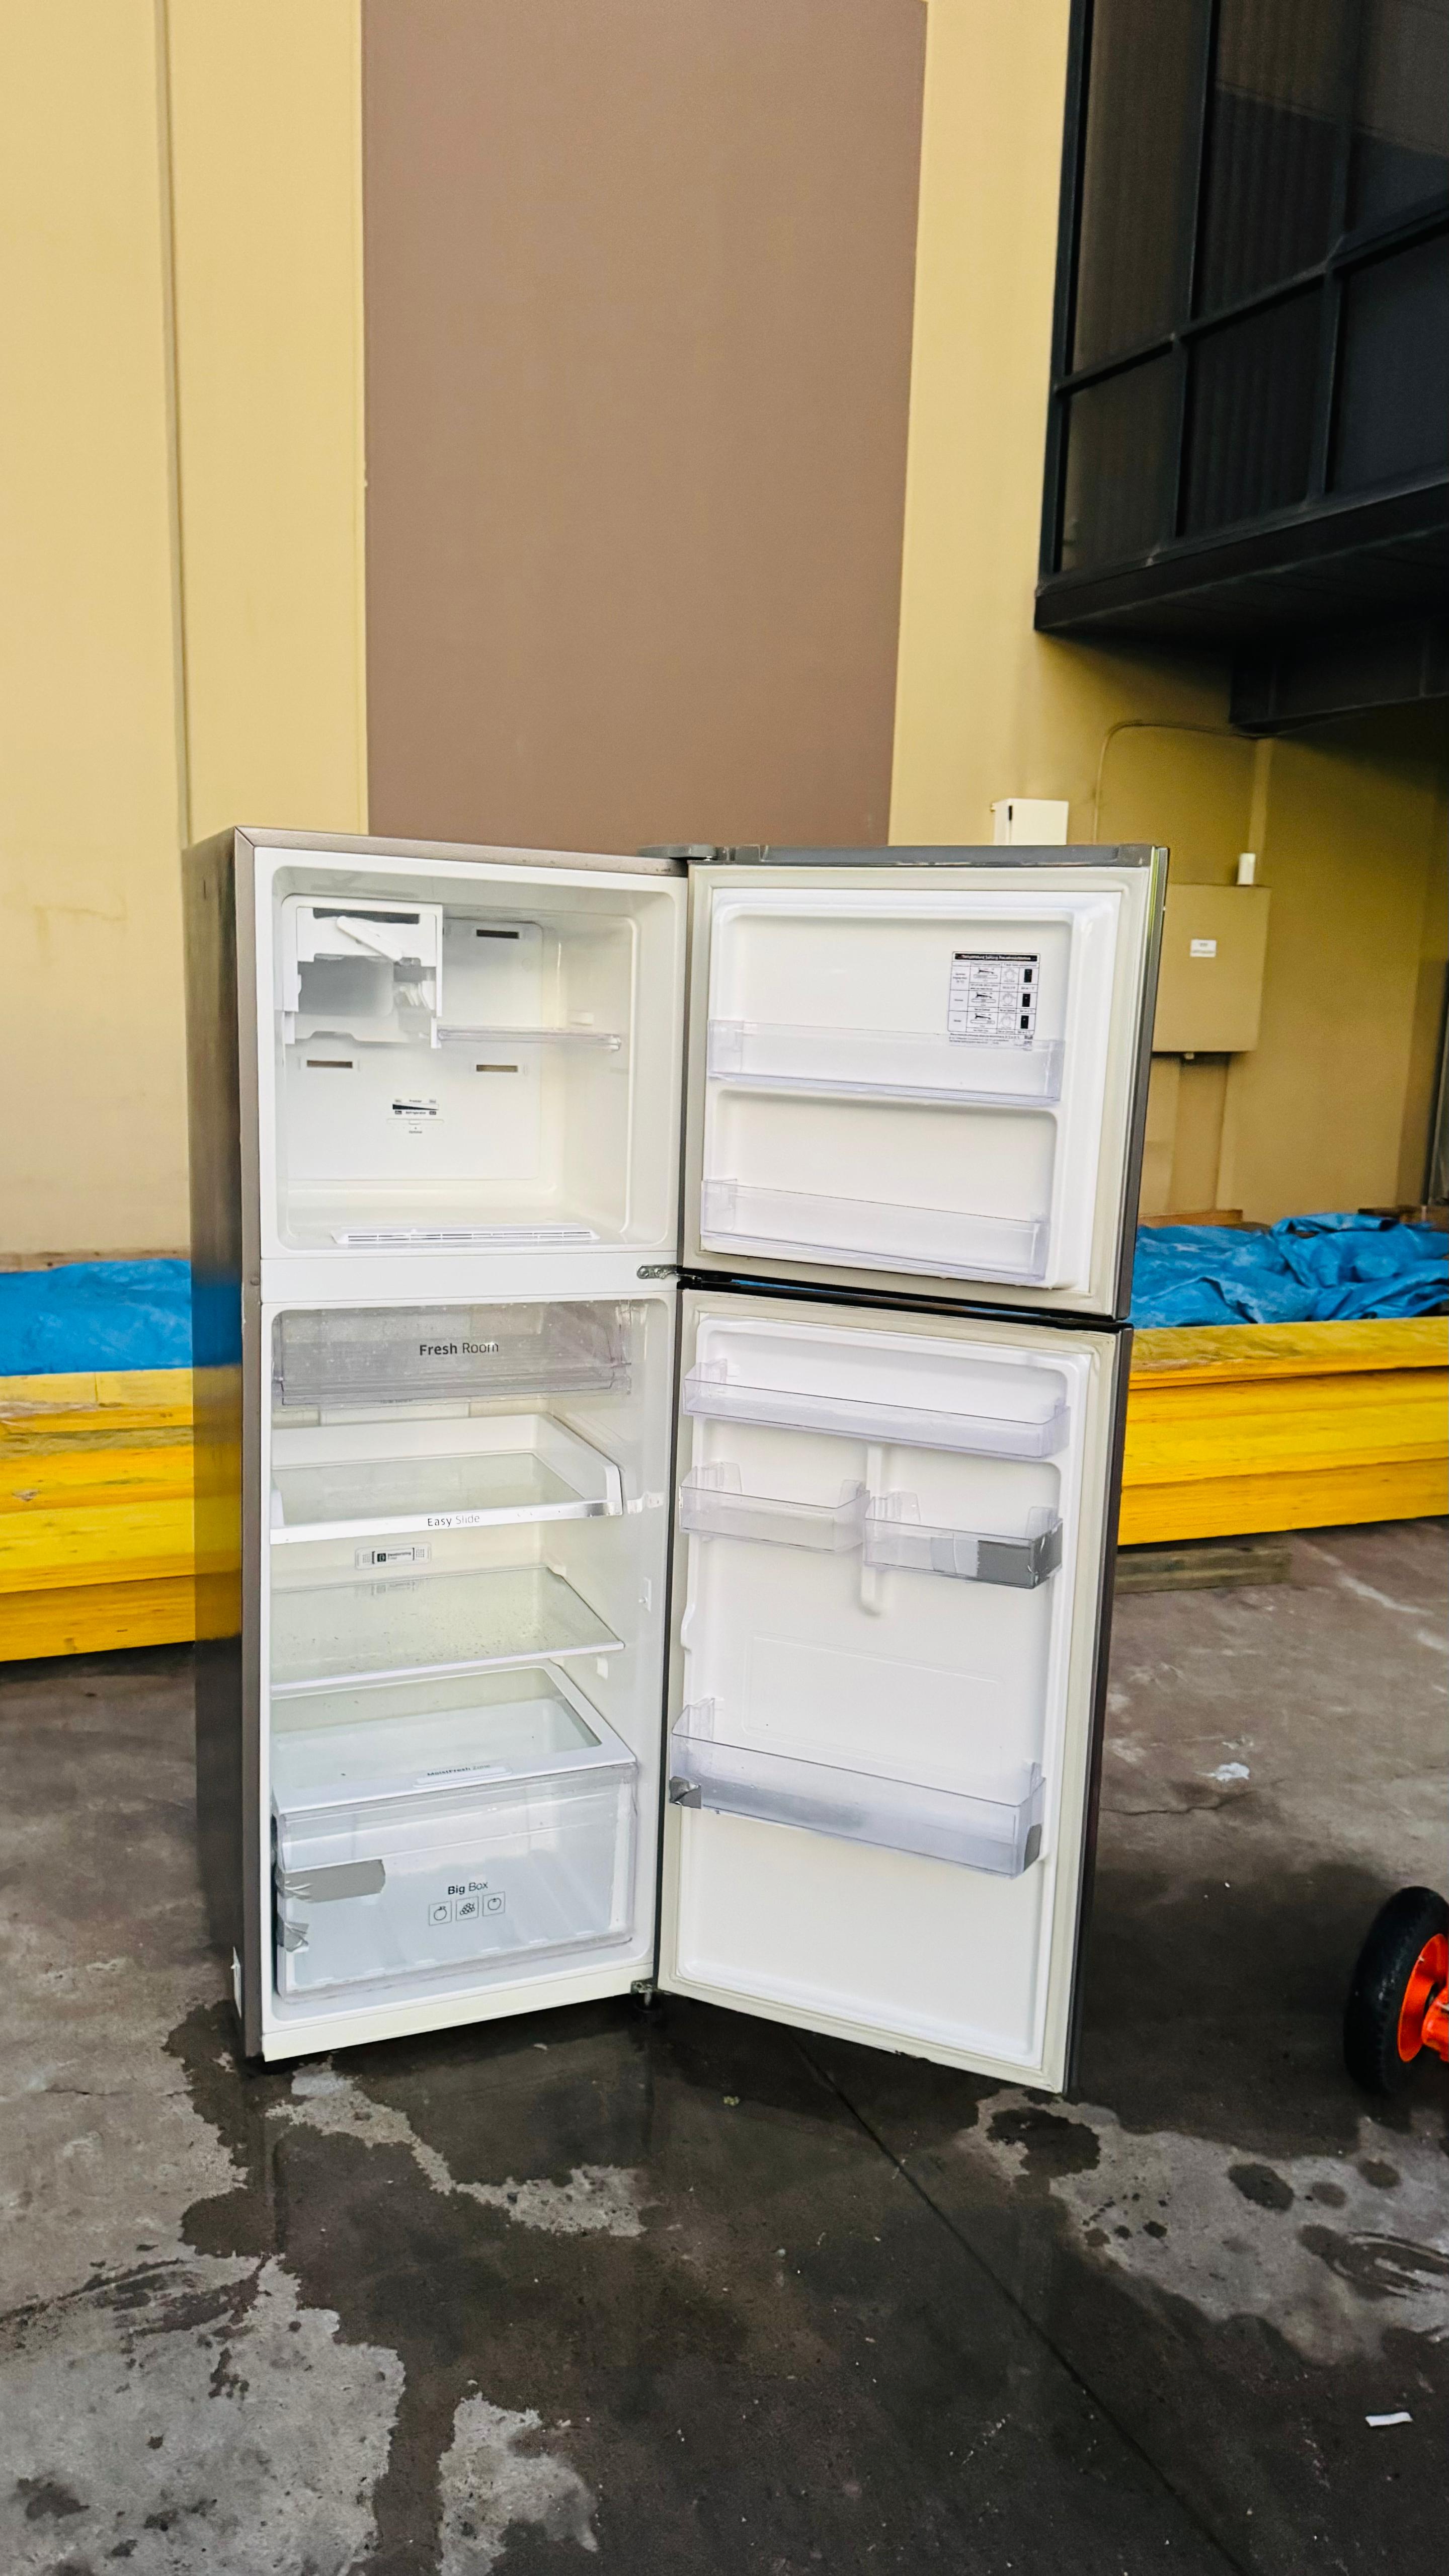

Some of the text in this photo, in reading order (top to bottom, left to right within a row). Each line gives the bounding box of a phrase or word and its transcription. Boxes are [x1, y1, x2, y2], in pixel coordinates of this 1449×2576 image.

[420, 1342, 499, 1355] Fresh Room
[428, 1515, 479, 1527] Easy Slide
[448, 1882, 488, 1895] Big Box
